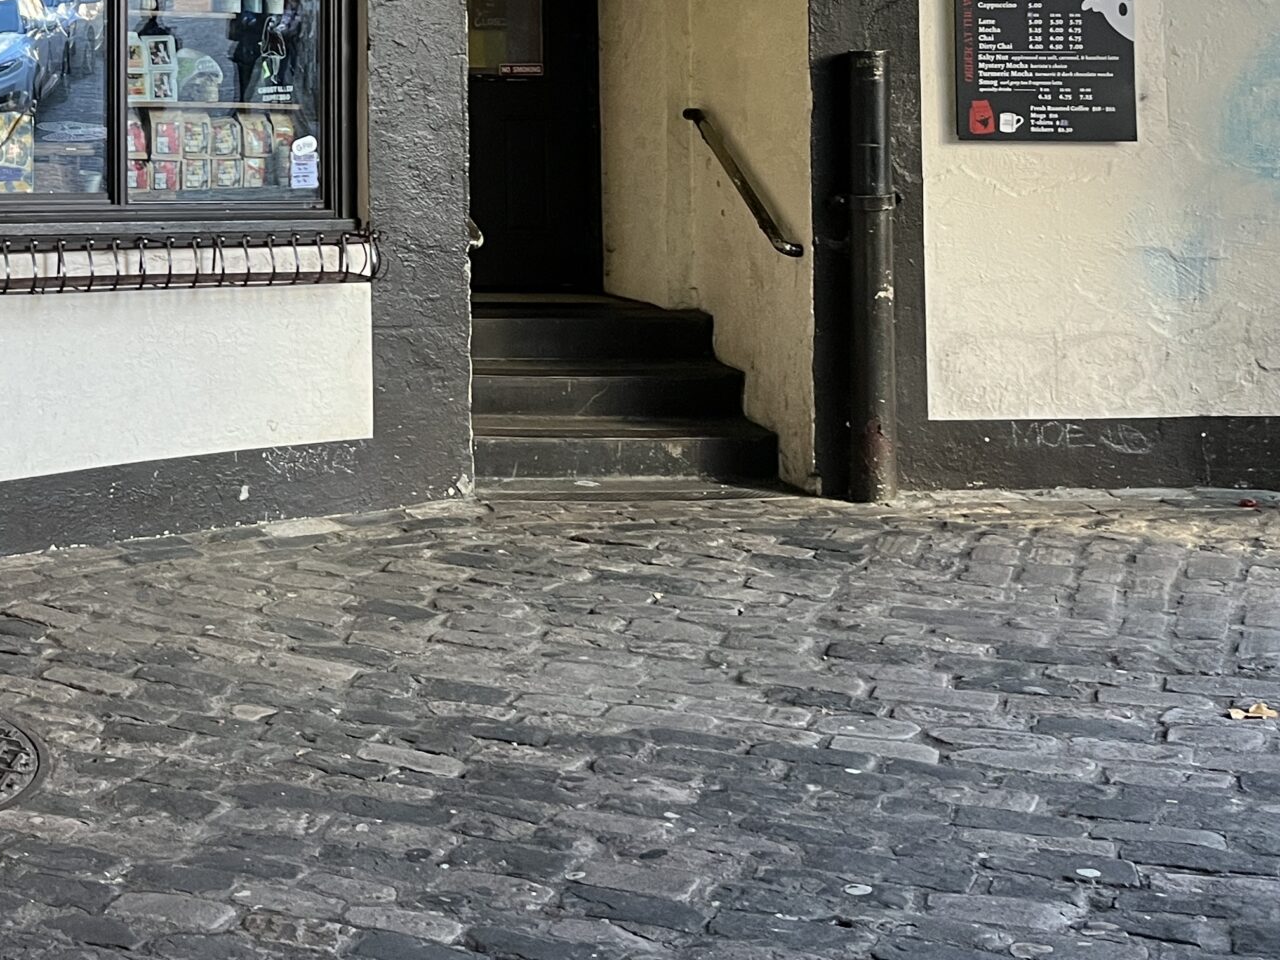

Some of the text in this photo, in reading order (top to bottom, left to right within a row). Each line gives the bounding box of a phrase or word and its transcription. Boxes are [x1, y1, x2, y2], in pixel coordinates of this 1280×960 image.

[978, 1, 1017, 10] Cappuccino
[978, 43, 996, 51] Dirty
[978, 54, 995, 62] Salty
[978, 62, 1005, 70] Mystery
